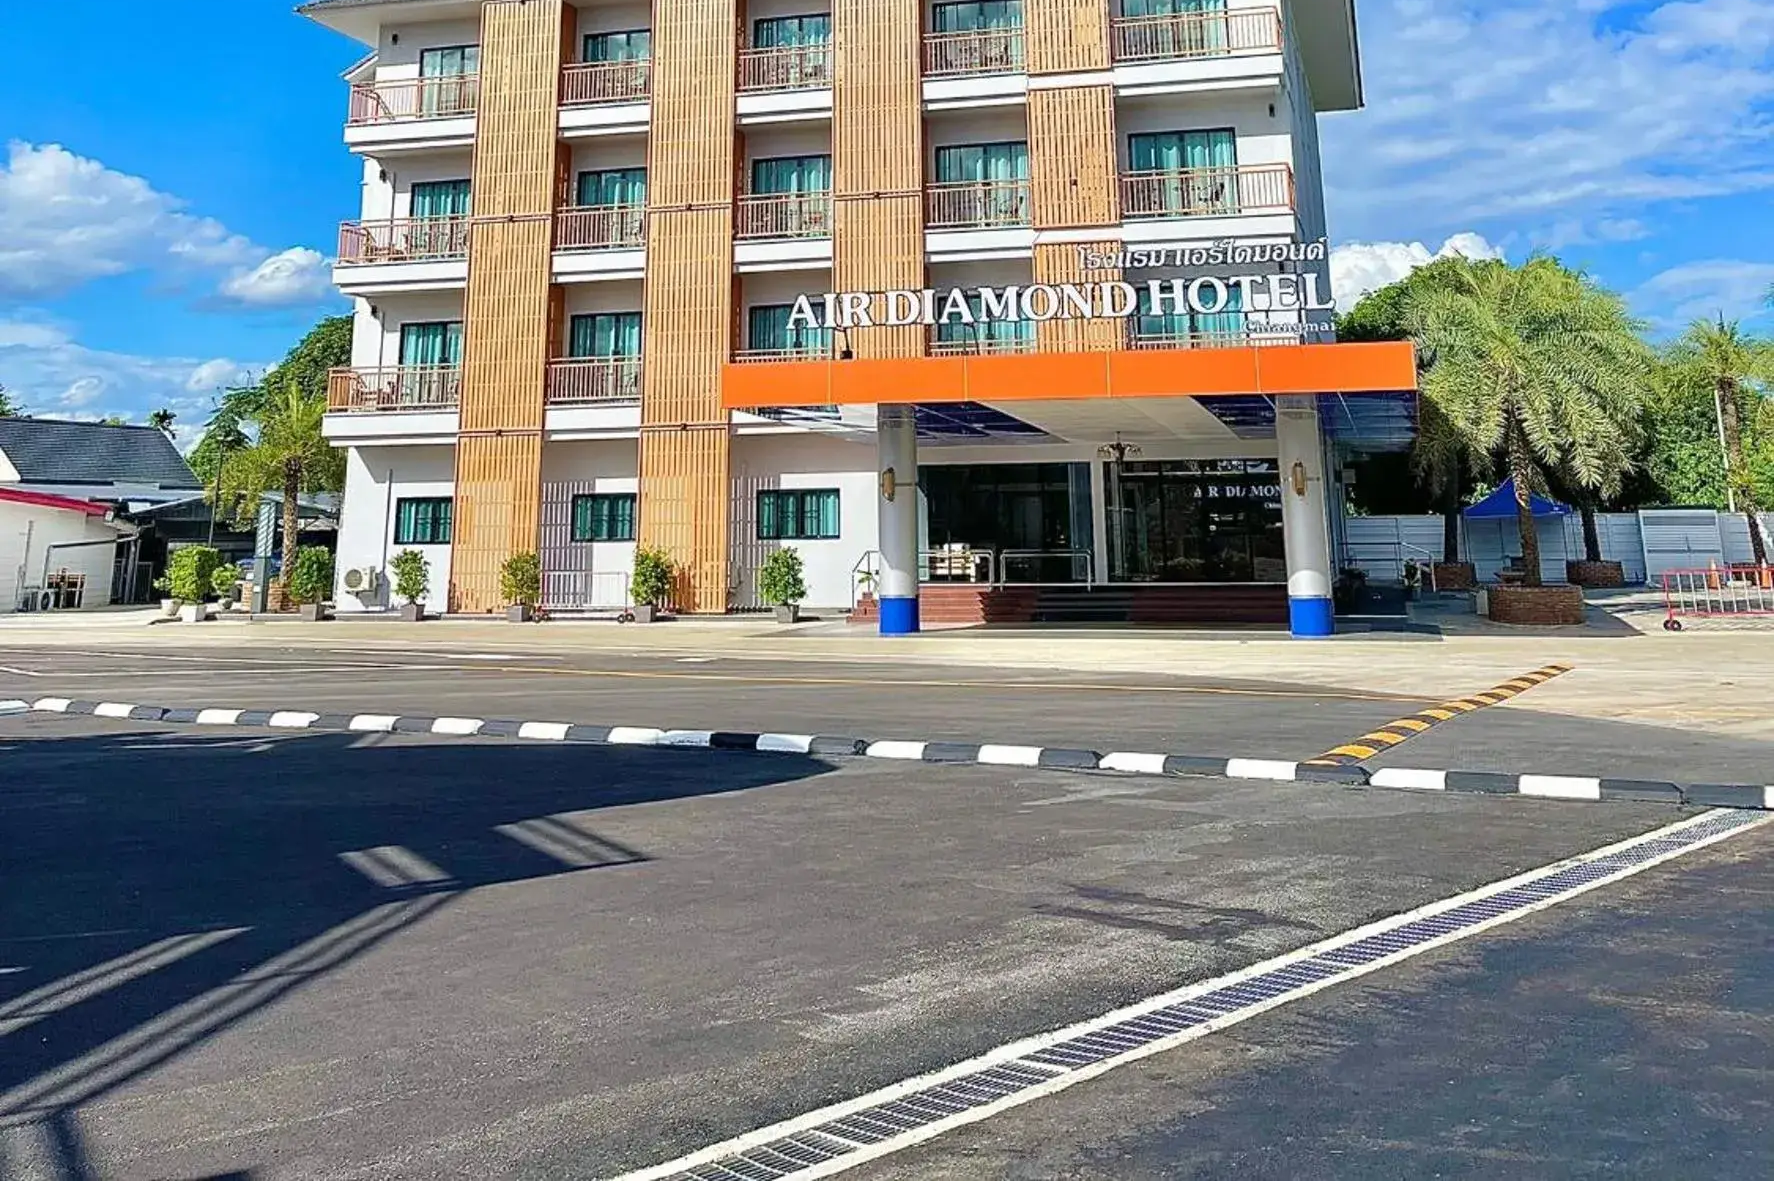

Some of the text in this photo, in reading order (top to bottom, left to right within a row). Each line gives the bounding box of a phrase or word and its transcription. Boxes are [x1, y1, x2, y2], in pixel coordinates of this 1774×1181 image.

[1076, 236, 1328, 270] โรงแรม แอร์ไดมอนด์
[786, 272, 1337, 330] AIR DIAMOND HOTEL
